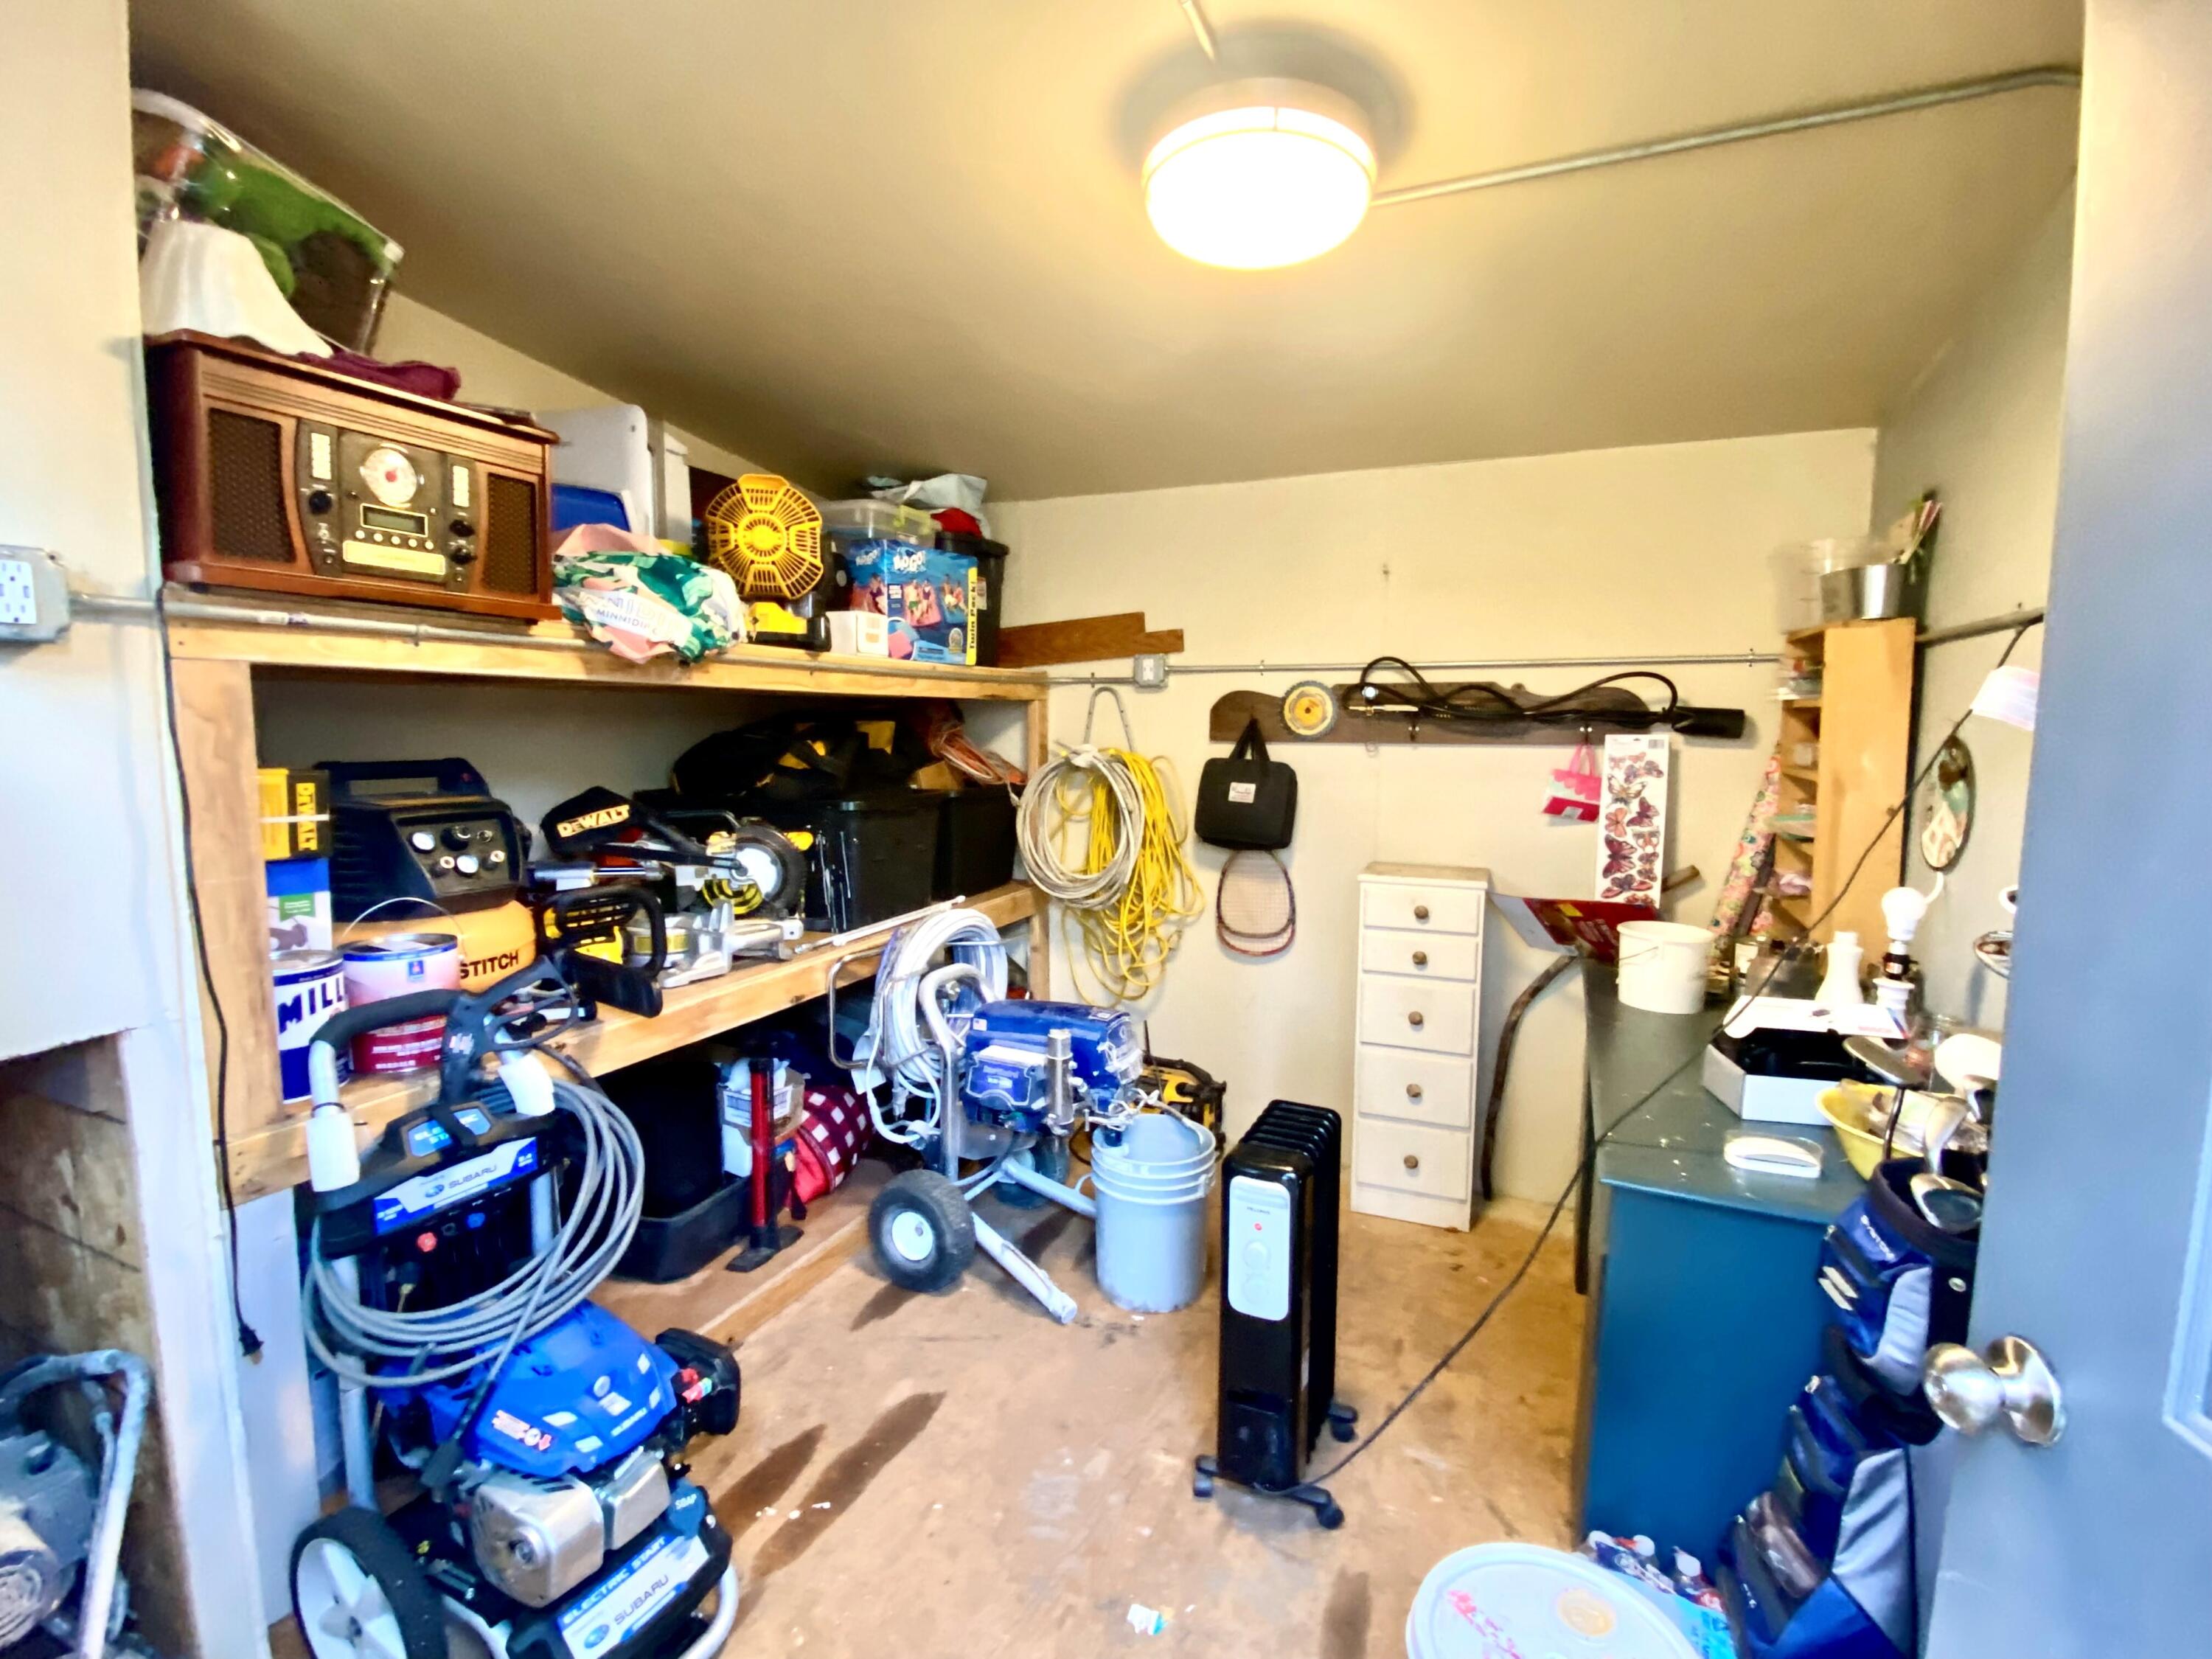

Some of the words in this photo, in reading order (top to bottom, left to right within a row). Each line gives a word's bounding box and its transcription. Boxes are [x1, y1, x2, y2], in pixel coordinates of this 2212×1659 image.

[557, 804, 630, 838] DEWALT
[448, 1165, 497, 1189] SUBARU
[563, 1568, 630, 1624] ELECTRIC
[614, 1574, 669, 1626] SUBARU
